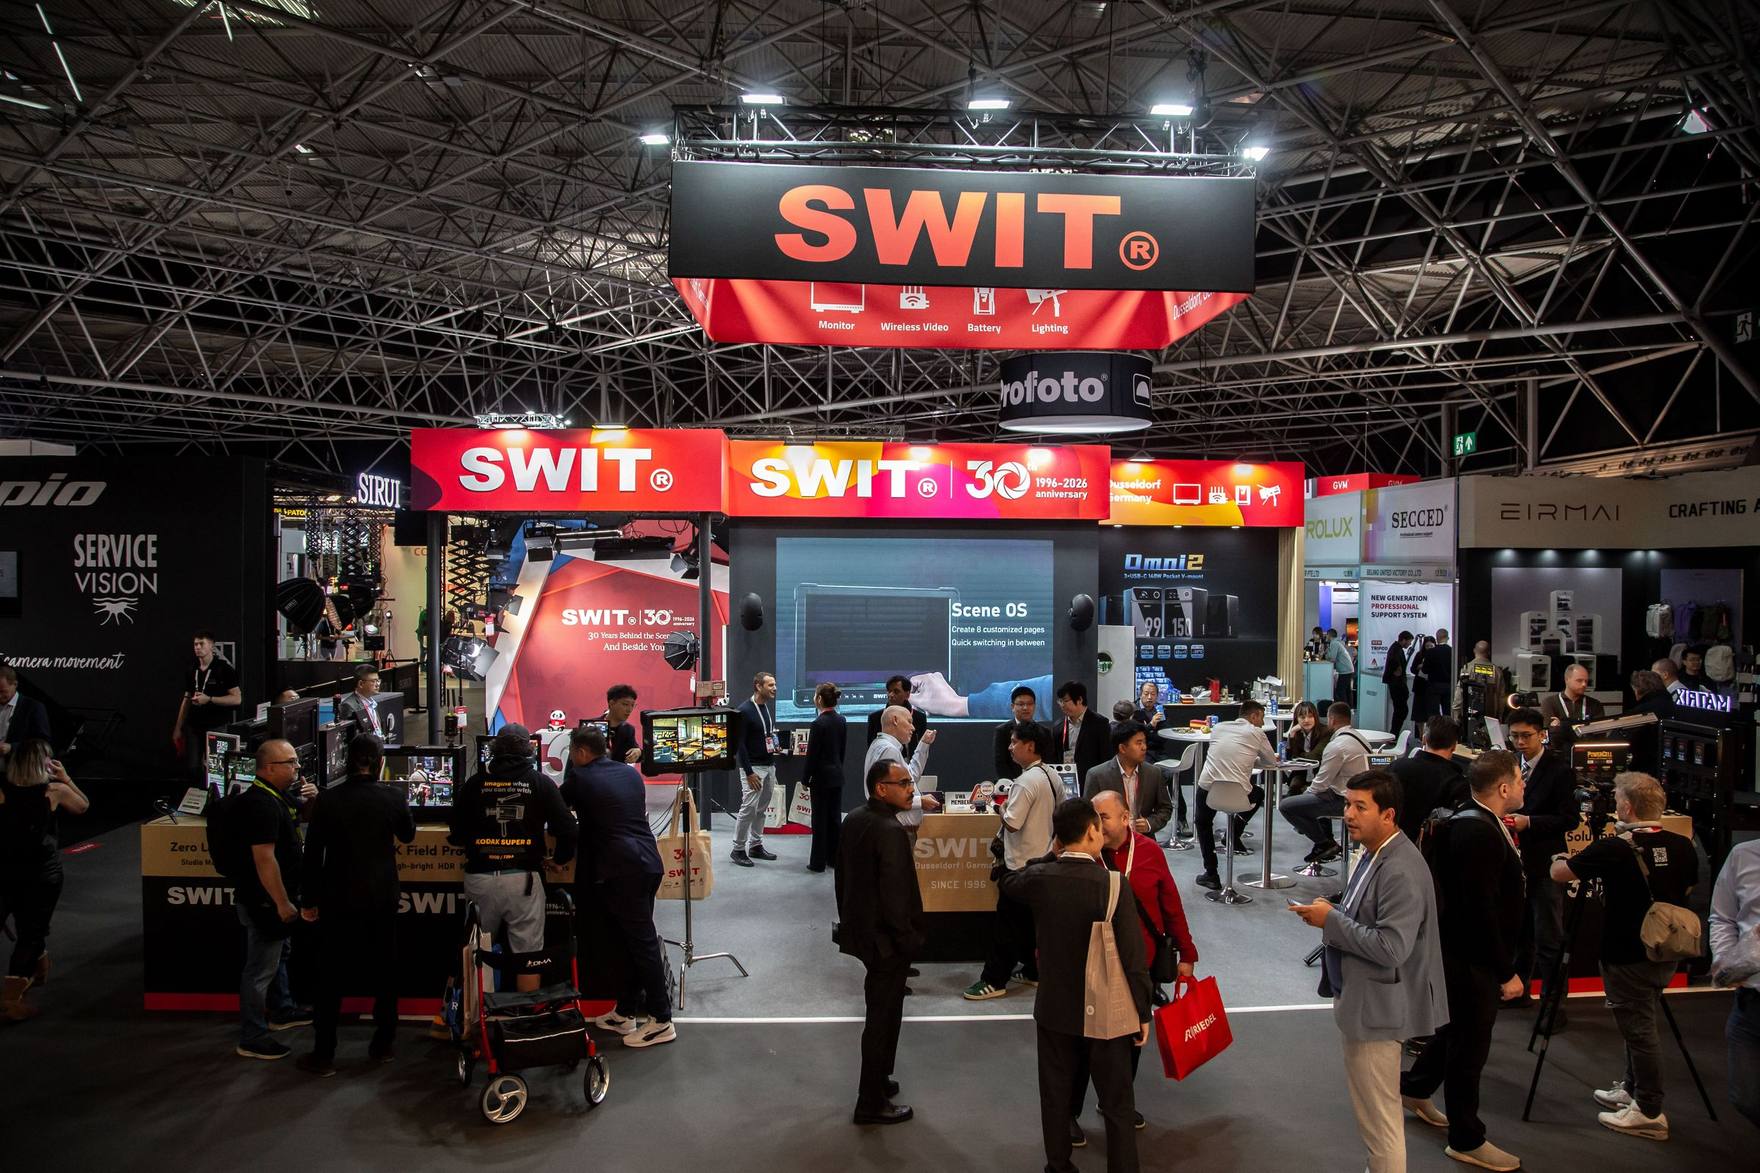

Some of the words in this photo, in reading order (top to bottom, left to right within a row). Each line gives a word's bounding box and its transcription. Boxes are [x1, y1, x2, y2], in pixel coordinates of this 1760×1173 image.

[818, 320, 855, 330] Monitor
[880, 322, 921, 332] Wireless
[923, 322, 949, 332] Video
[967, 323, 1001, 334] Battery
[1032, 323, 1069, 334] Lighting
[1035, 477, 1087, 488] 1996-2026
[1332, 481, 1349, 490] GVM
[0, 472, 109, 507] pio
[358, 472, 401, 508] SIRUI
[1035, 489, 1087, 500] anniversary
[1500, 503, 1620, 521] EIRMAI
[1668, 498, 1747, 518] CRAFTING
[1306, 516, 1353, 540] ROLUX
[73, 533, 159, 568] SERVICE
[1123, 553, 1205, 571] Omni2
[73, 572, 159, 594] VISION
[1386, 594, 1428, 602] GENERATION
[951, 602, 1000, 618] Scene
[1005, 602, 1028, 618] OS
[1171, 617, 1192, 637] 150
[587, 632, 599, 640] 30
[603, 642, 620, 651] And
[622, 642, 648, 651] Beside
[972, 639, 1006, 647] switching
[53, 651, 127, 670] movement
[170, 841, 198, 852] Zero
[501, 838, 526, 846] SUPER
[406, 844, 437, 856] Field
[181, 858, 203, 866] Studio
[668, 867, 701, 878] SWT
[930, 880, 959, 889] SINCE
[964, 880, 987, 889] 1996
[396, 891, 466, 914] SWI
